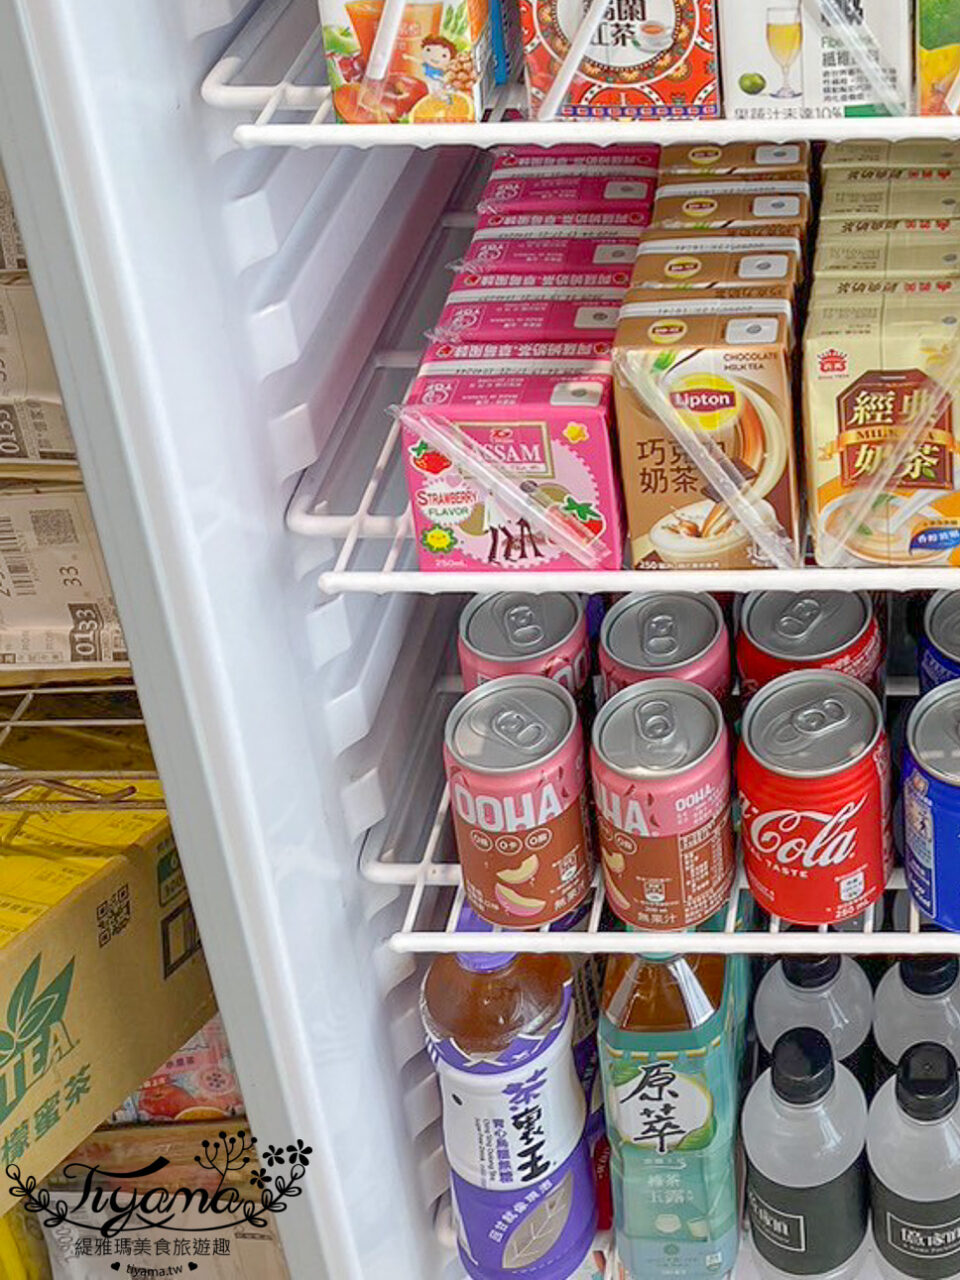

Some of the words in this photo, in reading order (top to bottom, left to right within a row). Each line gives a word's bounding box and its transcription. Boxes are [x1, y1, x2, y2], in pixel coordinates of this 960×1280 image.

[723, 352, 779, 362] CHOCOLATE
[749, 362, 765, 371] TEA
[674, 391, 731, 408] Lipton
[482, 443, 543, 464] SSAM
[852, 443, 941, 481] 奶茶
[638, 465, 699, 495] 奶茶
[416, 490, 479, 506] STRAWBERRY
[428, 507, 470, 517] FLAVOR
[74, 608, 98, 657] 0133
[453, 782, 563, 833] OOHA
[599, 778, 650, 838] HA
[766, 861, 809, 880] TASTE
[619, 1061, 687, 1154] 原萃
